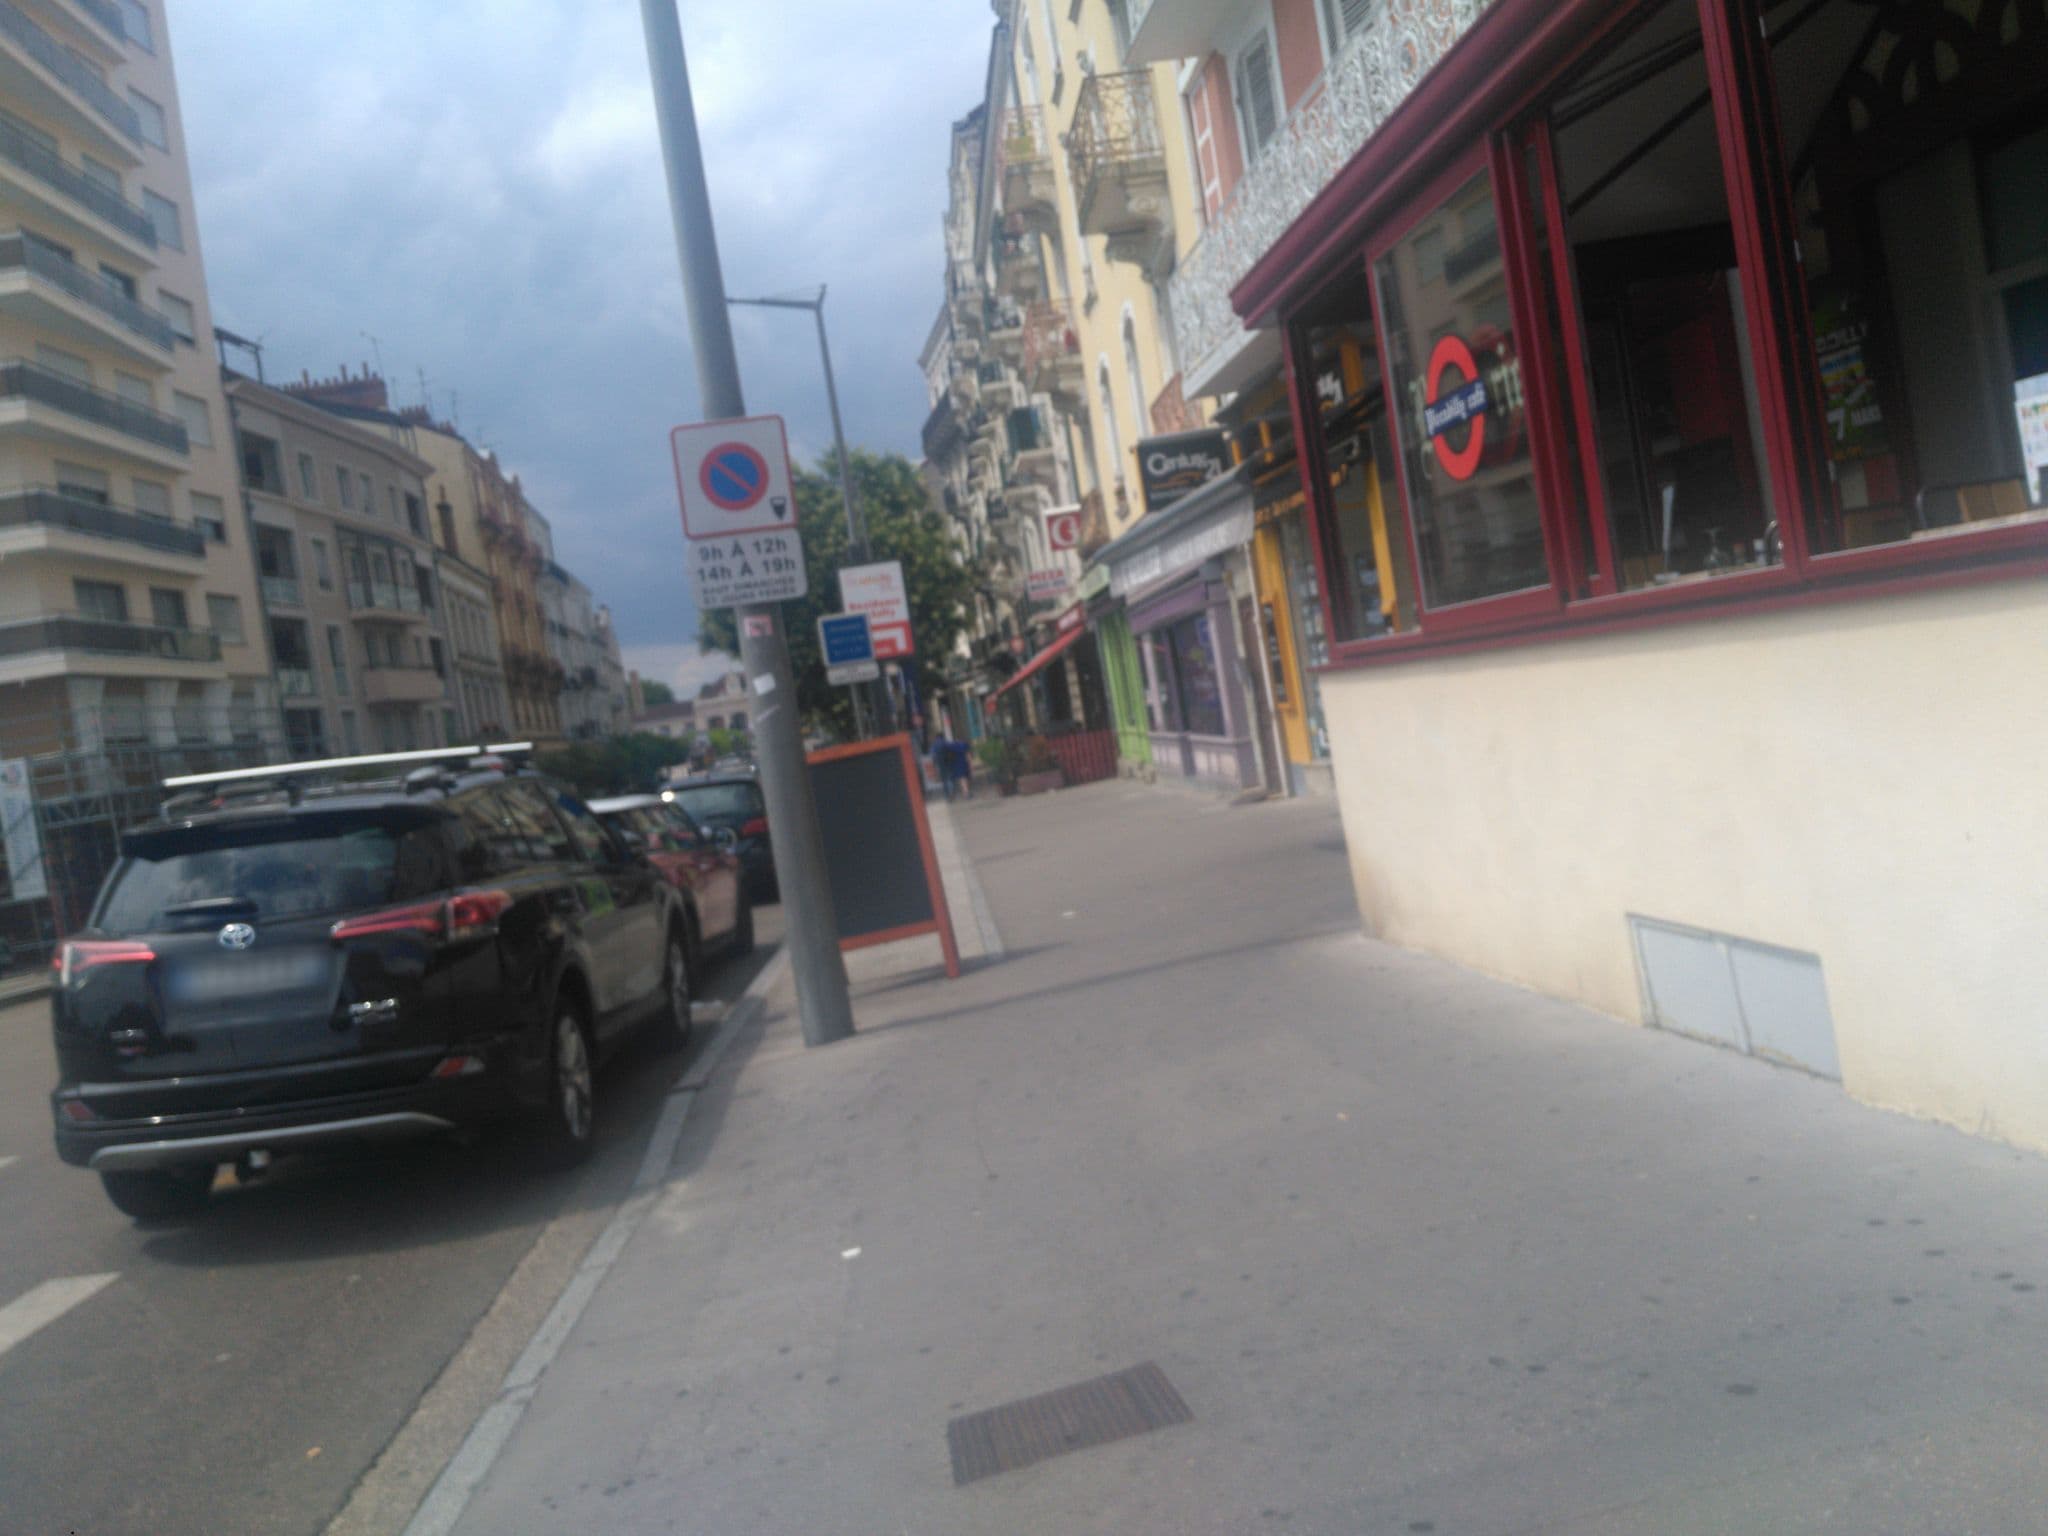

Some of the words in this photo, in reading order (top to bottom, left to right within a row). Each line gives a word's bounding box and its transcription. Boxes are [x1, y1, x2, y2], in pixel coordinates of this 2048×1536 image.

[698, 545, 723, 561] 9h
[753, 538, 787, 555] 12h
[697, 565, 732, 581] 14h
[763, 556, 796, 573] 19h
